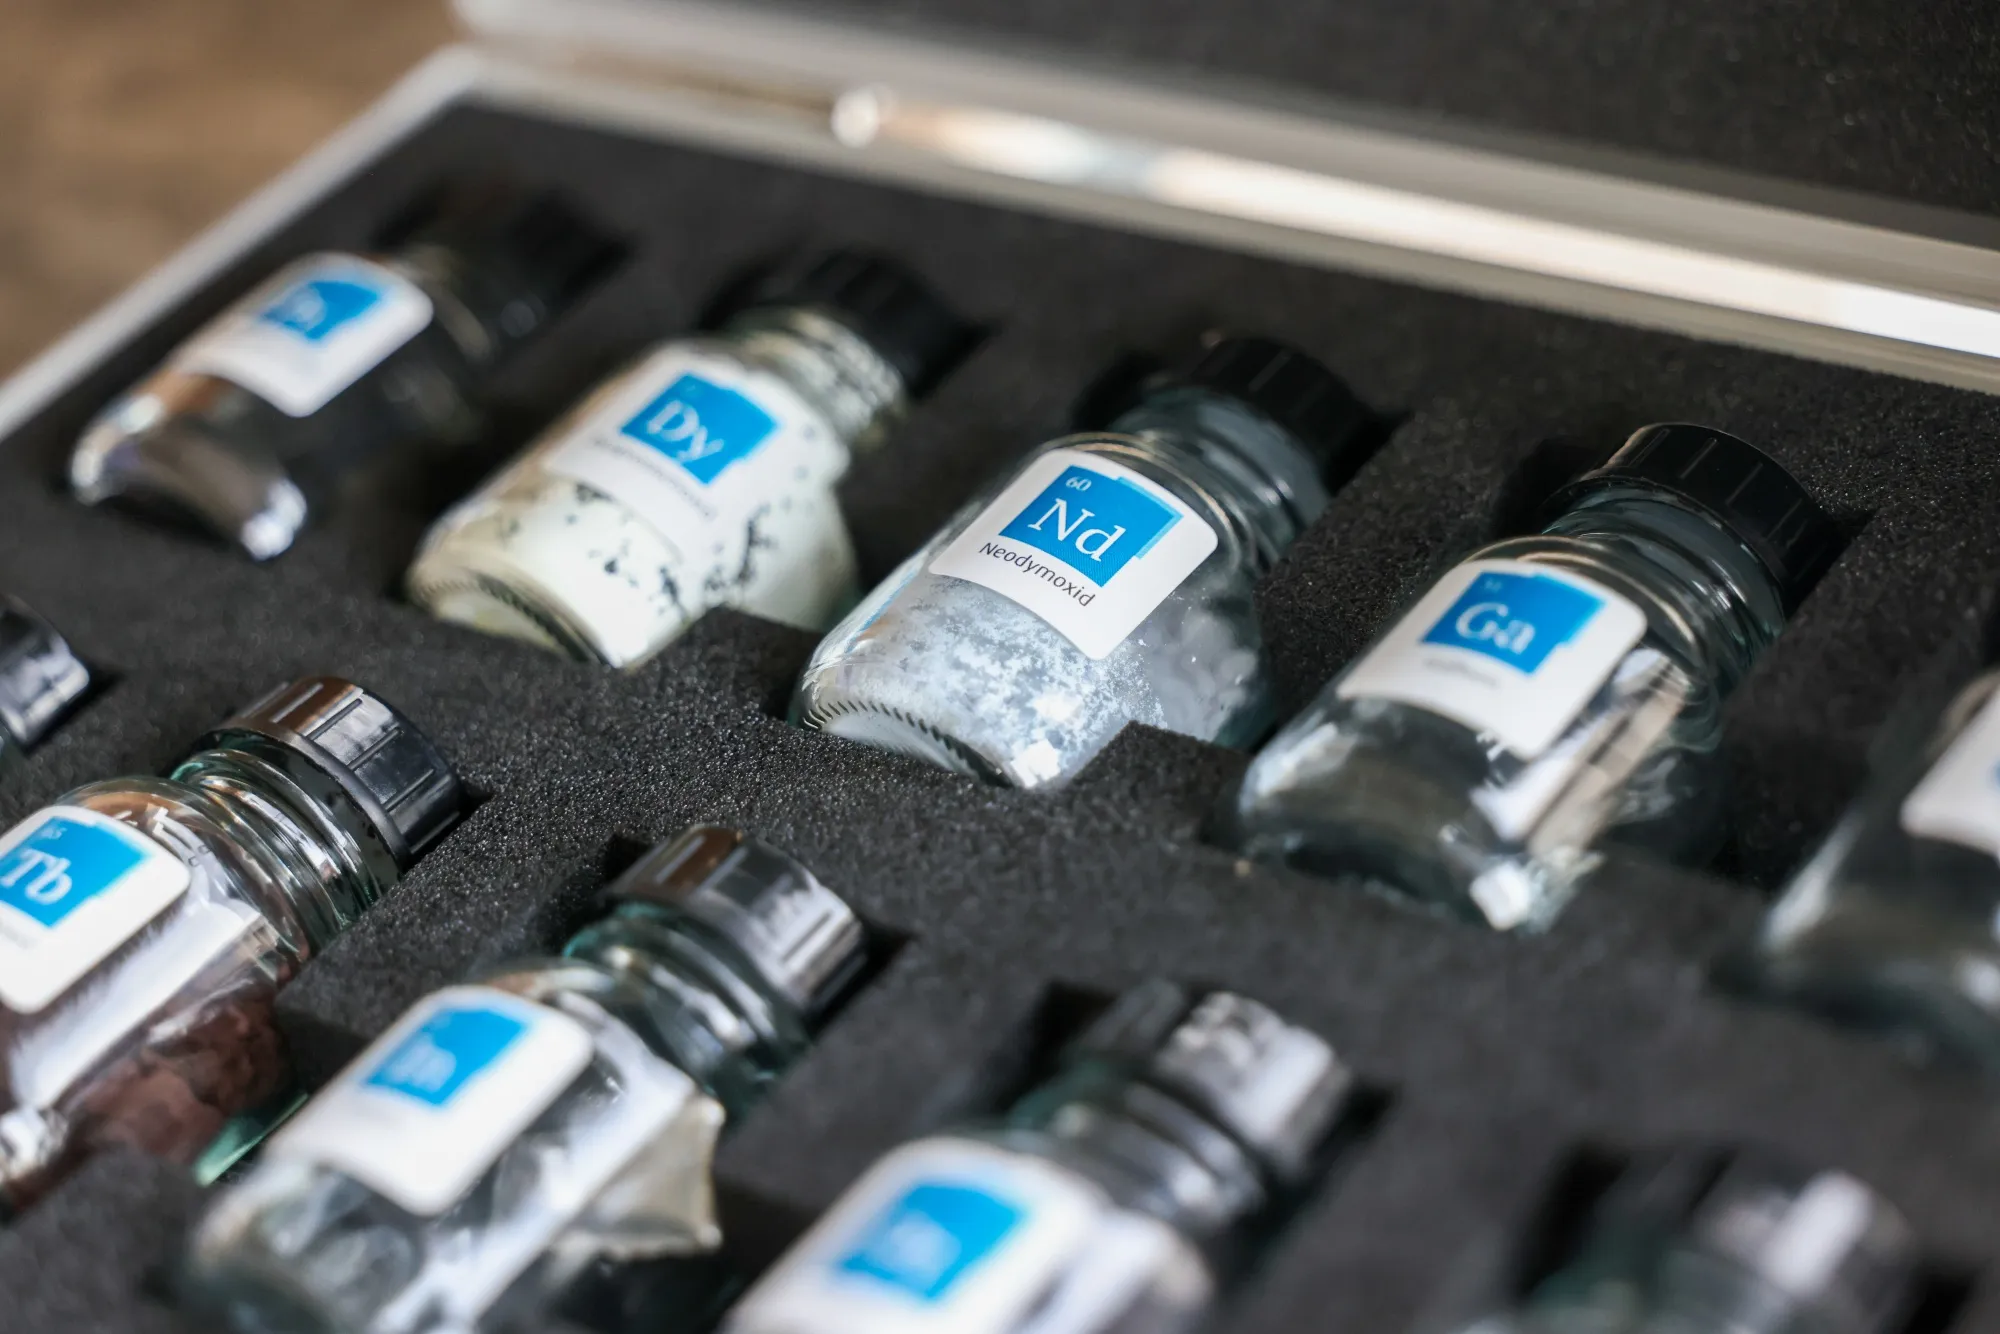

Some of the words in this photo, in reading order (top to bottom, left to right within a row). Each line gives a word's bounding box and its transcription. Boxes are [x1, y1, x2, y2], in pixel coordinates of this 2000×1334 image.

[646, 399, 725, 463] Dy
[1065, 475, 1092, 493] 60
[1027, 498, 1127, 562] Nd
[978, 541, 1097, 608] Neodymoxid
[1455, 602, 1536, 654] Ga
[0, 847, 73, 905] Tb
